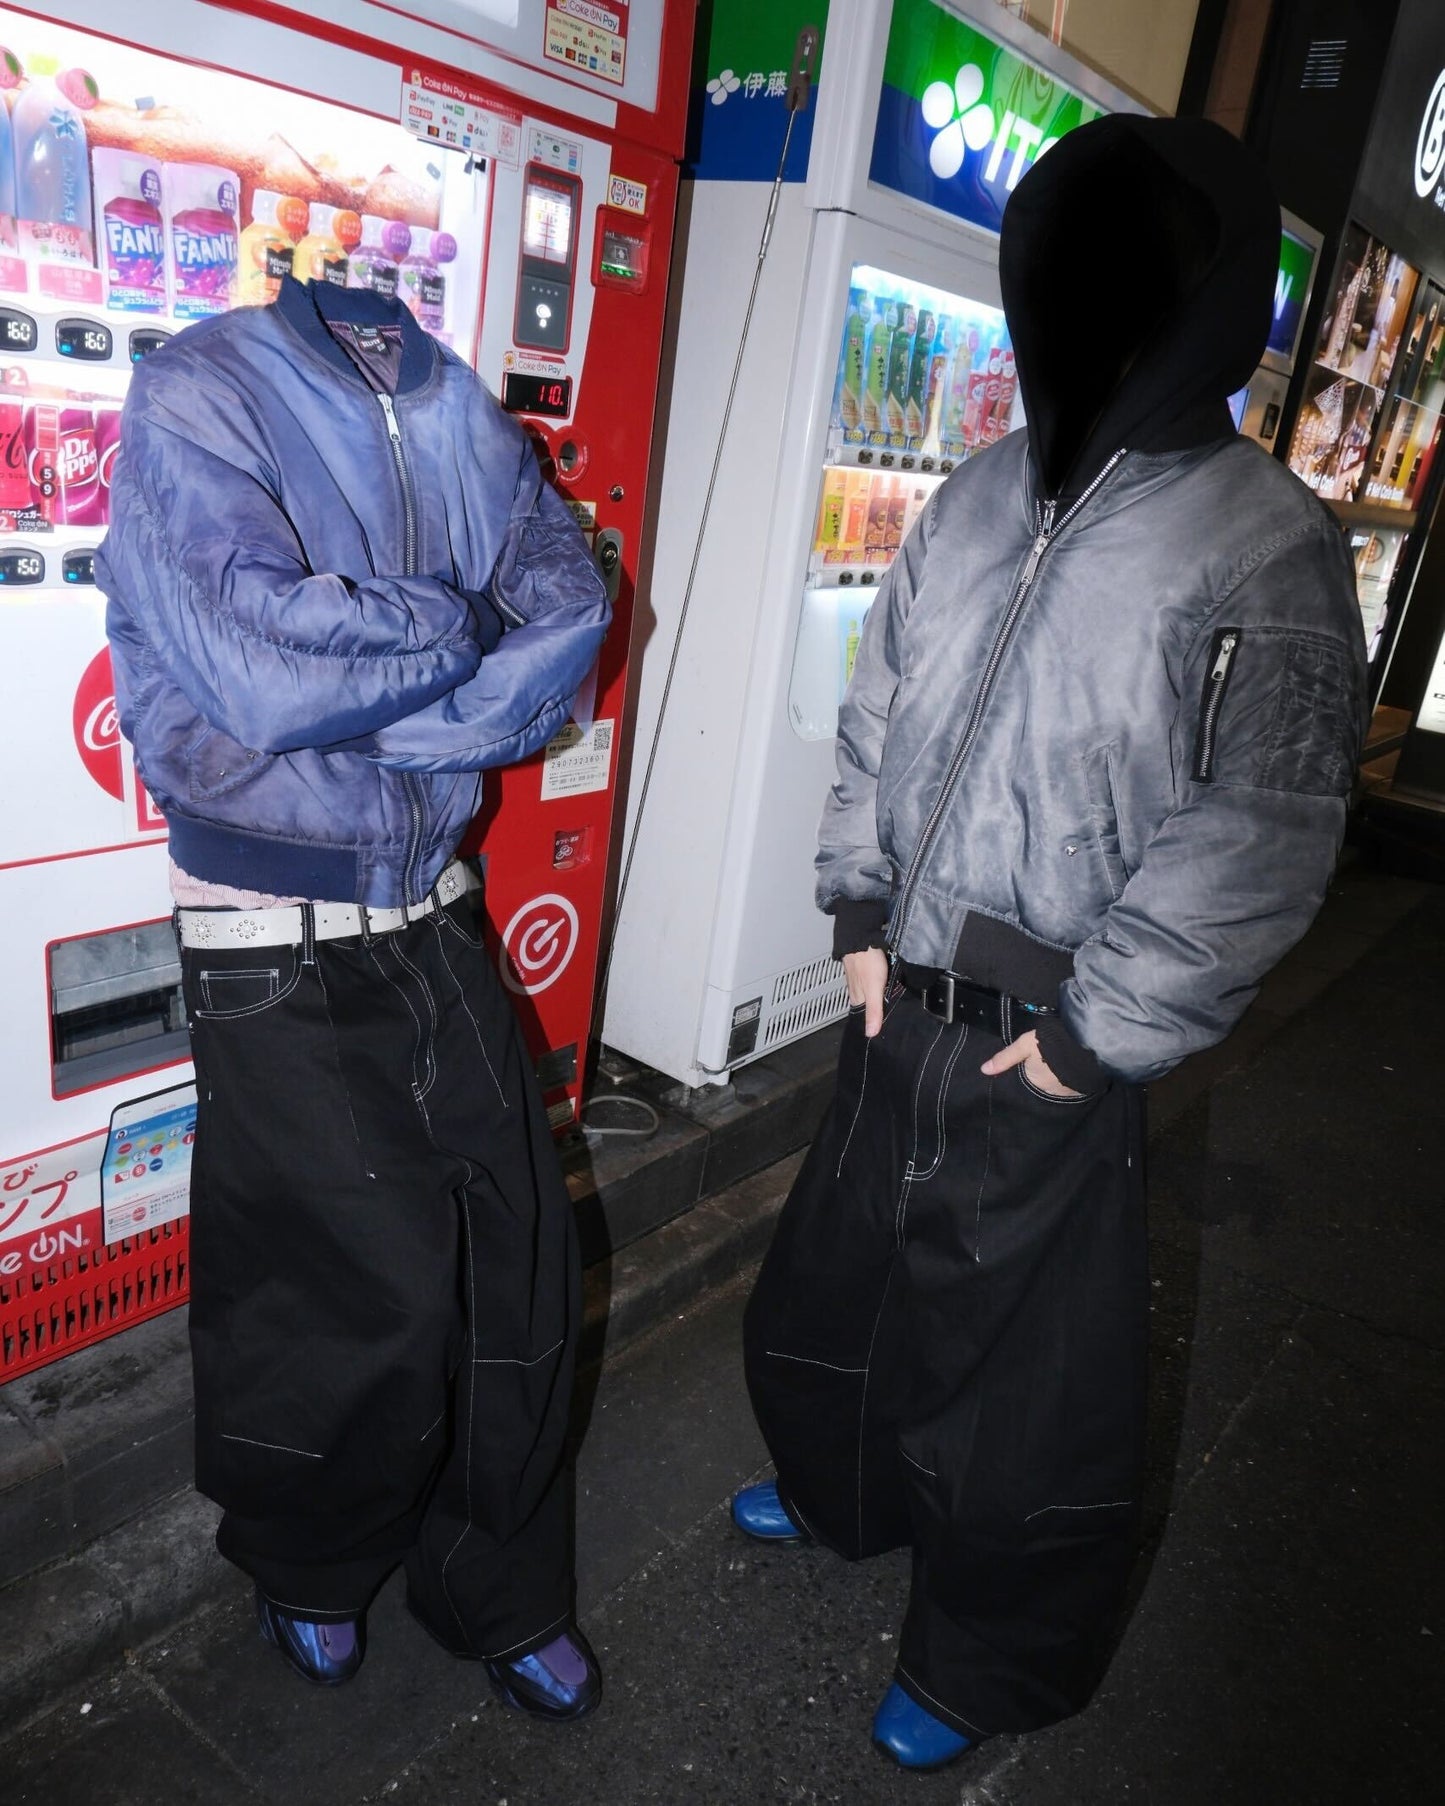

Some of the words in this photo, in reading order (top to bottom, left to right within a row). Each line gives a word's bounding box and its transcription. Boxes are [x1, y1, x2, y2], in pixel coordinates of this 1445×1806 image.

[569, 0, 590, 17] Coke
[603, 14, 618, 32] Pay
[550, 43, 563, 54] VISA
[423, 76, 441, 91] Coke
[453, 87, 468, 101] Pay
[628, 197, 640, 210] OK
[377, 284, 393, 294] Maid
[426, 292, 441, 302] Maid
[7, 321, 31, 341] 160
[85, 331, 106, 351] 160
[518, 359, 536, 371] Coke
[548, 364, 562, 376] Pay
[64, 438, 89, 460] Dr
[3, 1163, 39, 1191] び
